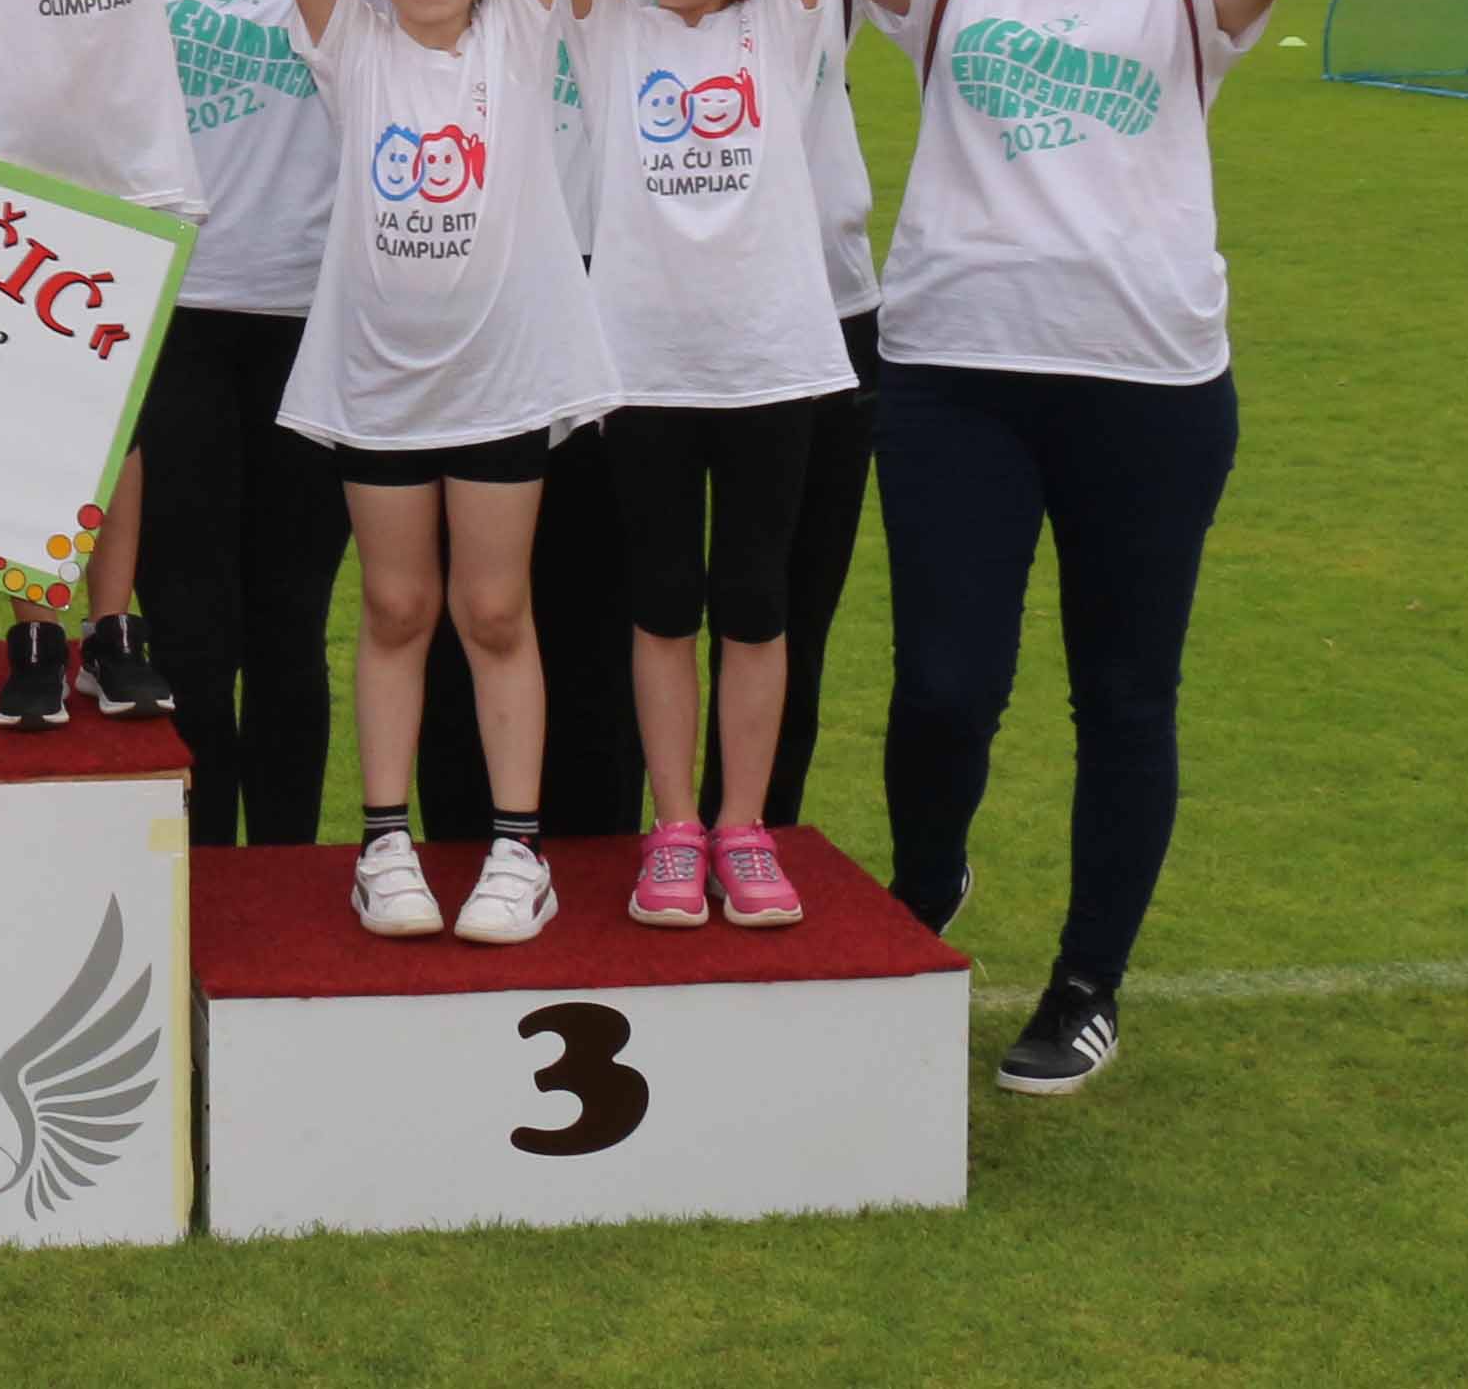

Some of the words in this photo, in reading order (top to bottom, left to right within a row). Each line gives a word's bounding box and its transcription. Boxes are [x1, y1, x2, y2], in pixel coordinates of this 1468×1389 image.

[999, 117, 1089, 161] 2022.
[650, 153, 674, 171] JA
[682, 147, 712, 169] ĆU
[720, 148, 753, 168] BITI
[646, 172, 751, 196] OLIMPIJAC
[406, 210, 433, 234] ĆU
[442, 212, 477, 233] BITI
[376, 234, 472, 260] OLIMPIJAC
[510, 1002, 649, 1156] 3
